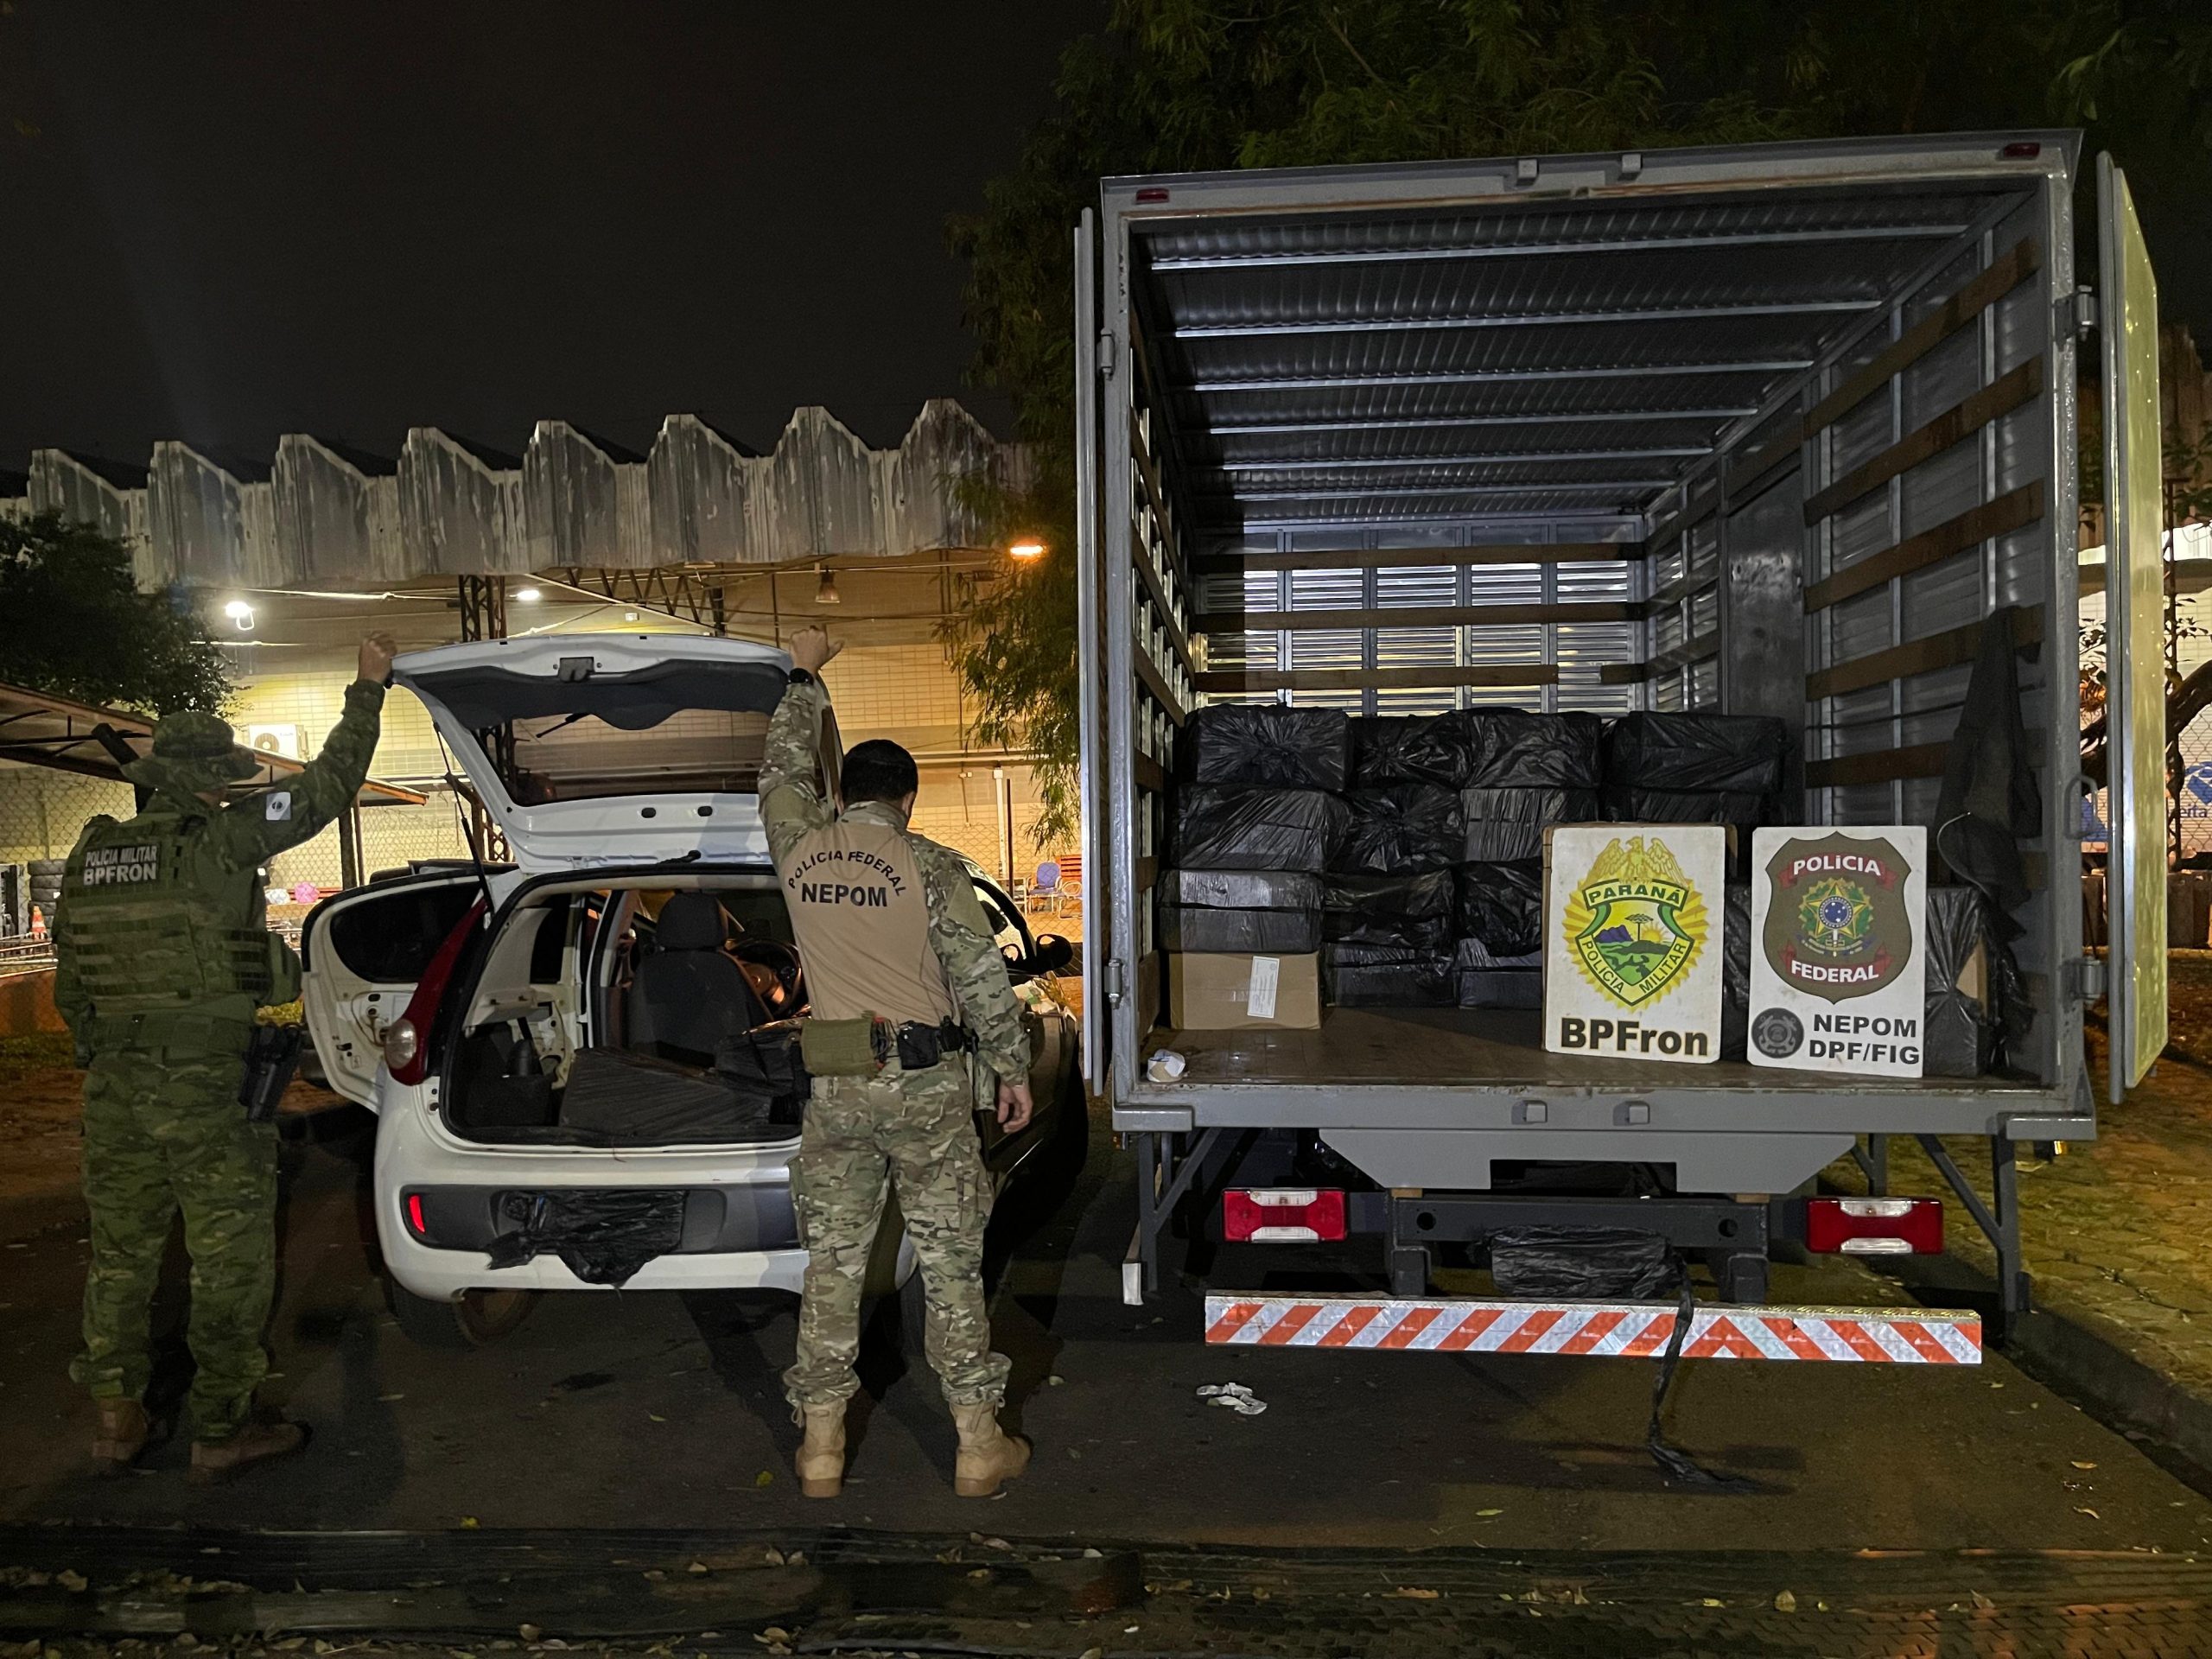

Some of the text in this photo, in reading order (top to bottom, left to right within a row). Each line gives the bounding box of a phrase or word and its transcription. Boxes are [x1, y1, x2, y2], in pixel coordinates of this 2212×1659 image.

[120, 846, 157, 863] MILITAR
[83, 863, 156, 886] BPFRON
[848, 851, 906, 897] FEDERAL
[801, 882, 887, 907] NEPOM
[1588, 884, 1681, 905] PARANÁ
[1638, 943, 1687, 994] MILITAR
[1791, 959, 1879, 982] FEDERAL
[1560, 1016, 1708, 1056] BPFron
[1813, 1014, 1916, 1038] NEPOM
[1809, 1039, 1920, 1065] DPF/FIG
